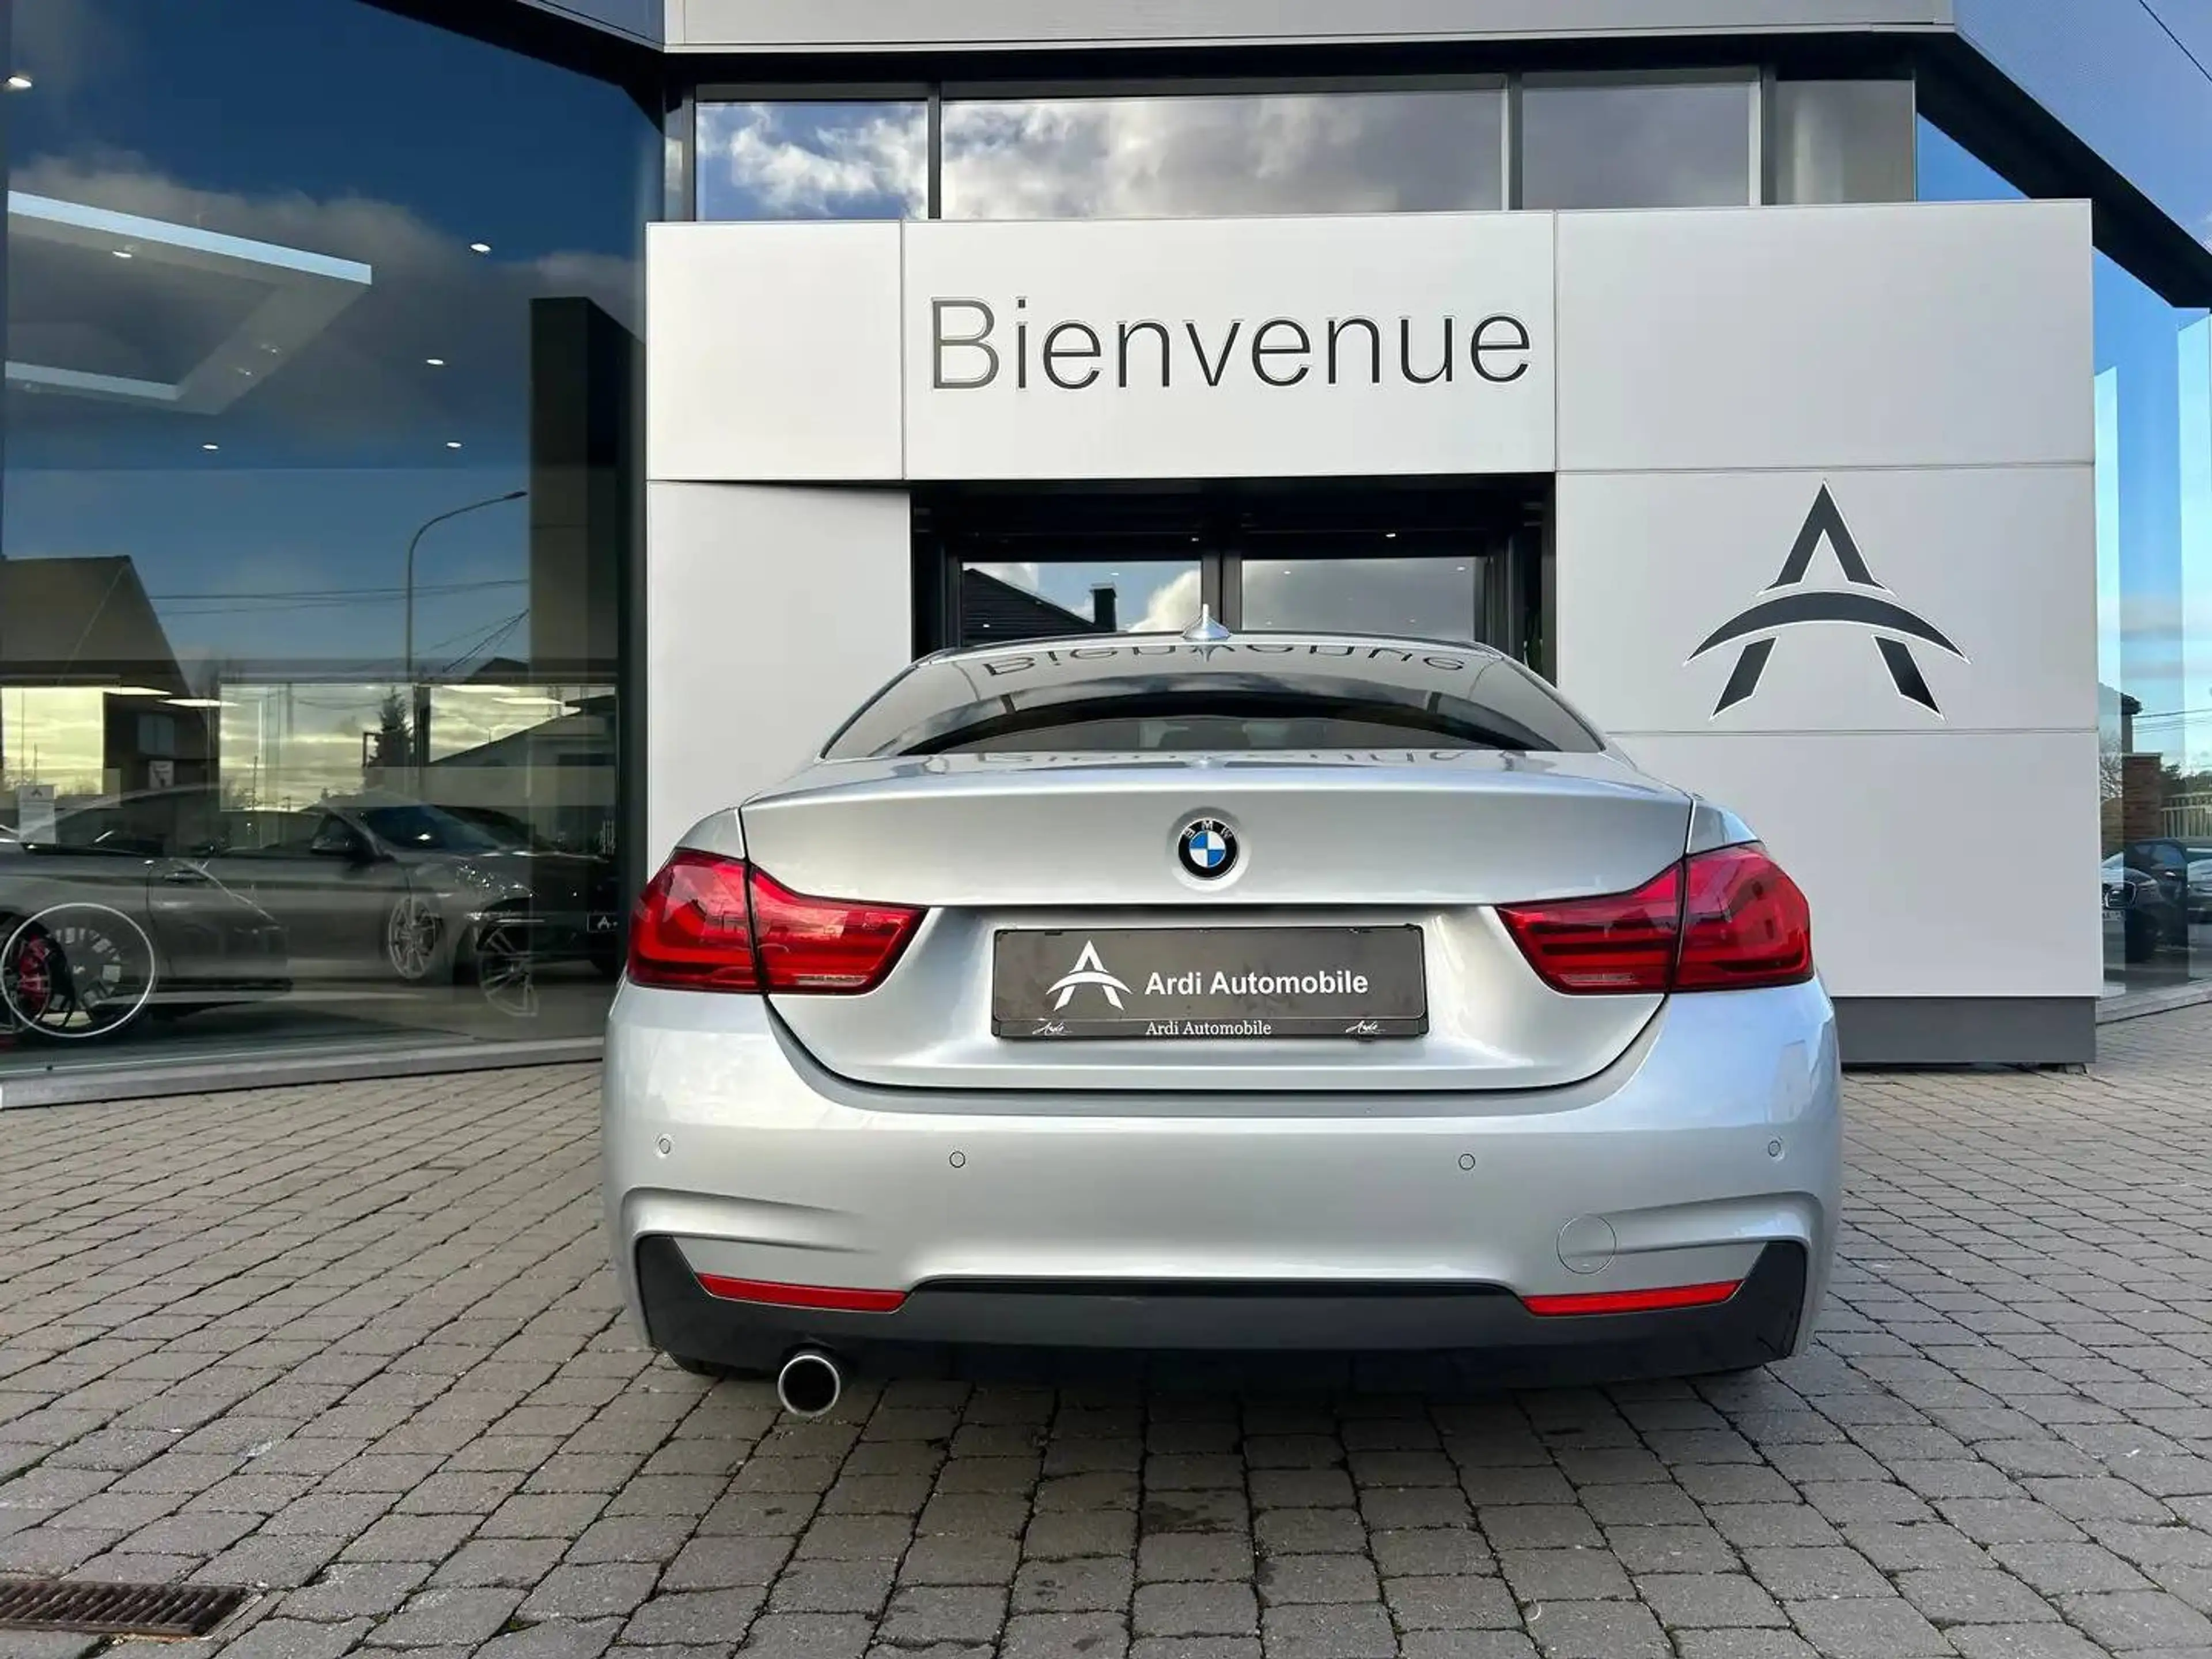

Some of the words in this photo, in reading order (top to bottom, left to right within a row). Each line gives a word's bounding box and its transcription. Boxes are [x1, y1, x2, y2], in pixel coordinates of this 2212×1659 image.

[930, 296, 1532, 390] Bienvenue
[1145, 971, 1202, 995] Ardi
[1210, 970, 1369, 995] Automobile
[1145, 1021, 1179, 1035] Ardi
[1183, 1020, 1272, 1036] Automobile
